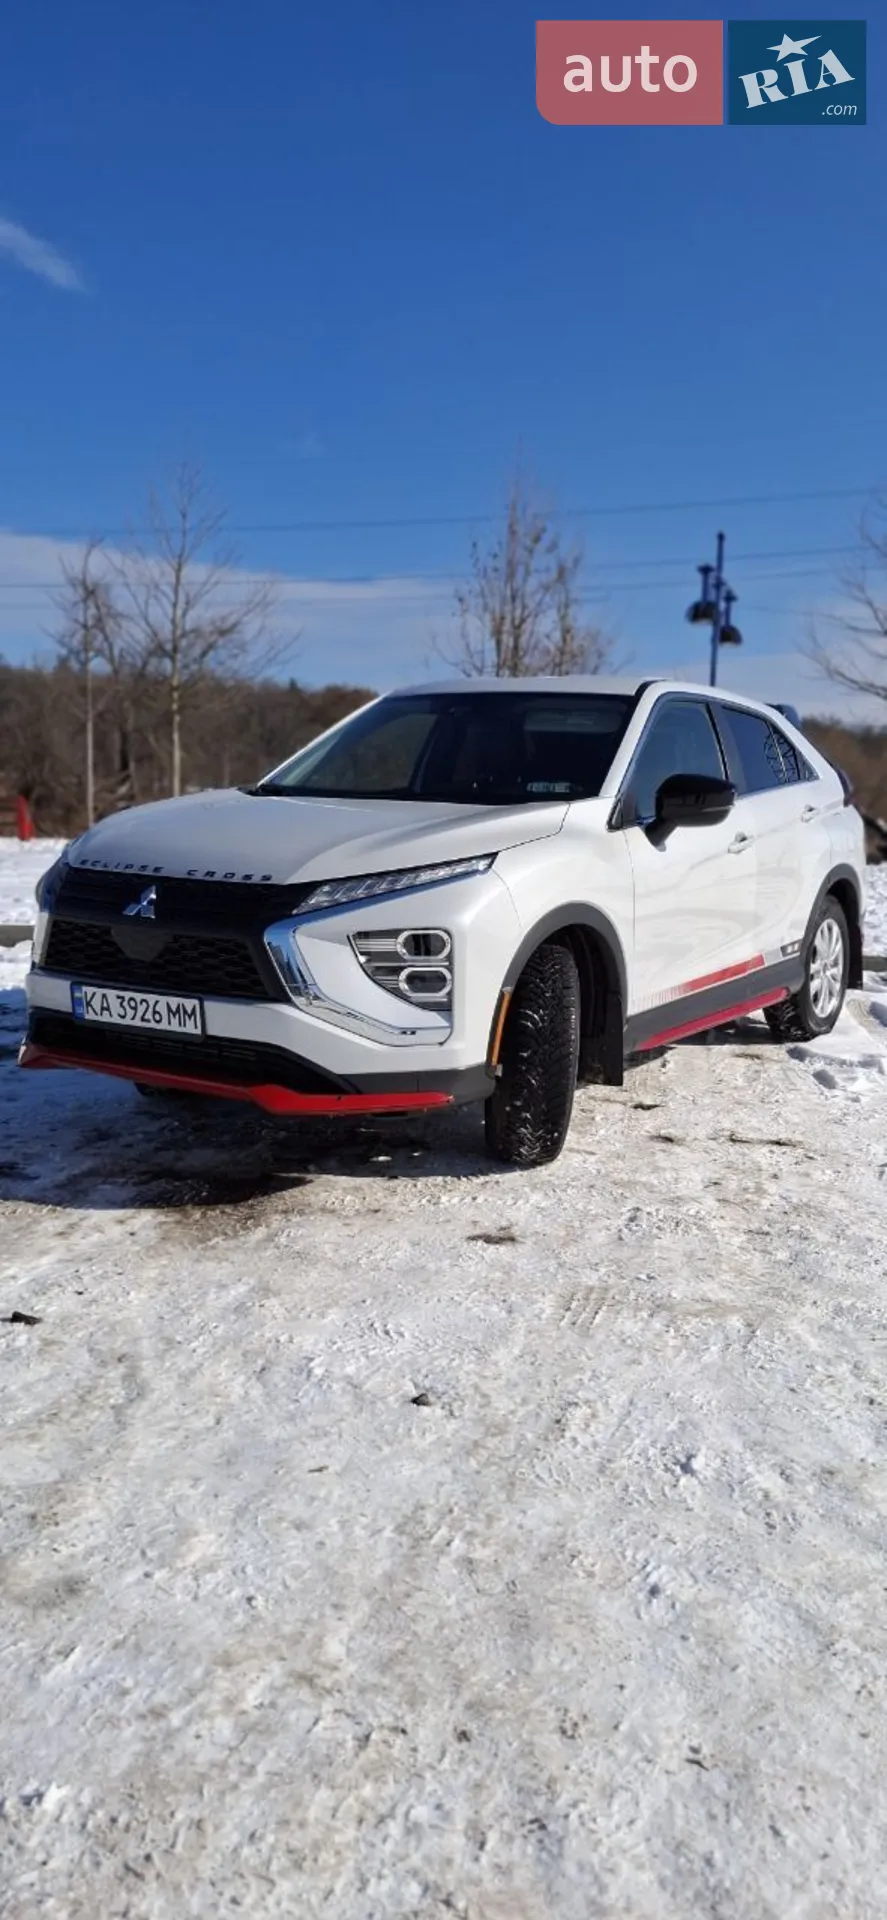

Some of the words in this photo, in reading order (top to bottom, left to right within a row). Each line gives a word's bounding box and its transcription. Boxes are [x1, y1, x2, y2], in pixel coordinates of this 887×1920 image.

[79, 859, 165, 873] ECLIPSE
[186, 869, 274, 882] CROSS
[84, 991, 112, 1018] KA
[116, 995, 163, 1024] 3926
[166, 1001, 198, 1029] MM
